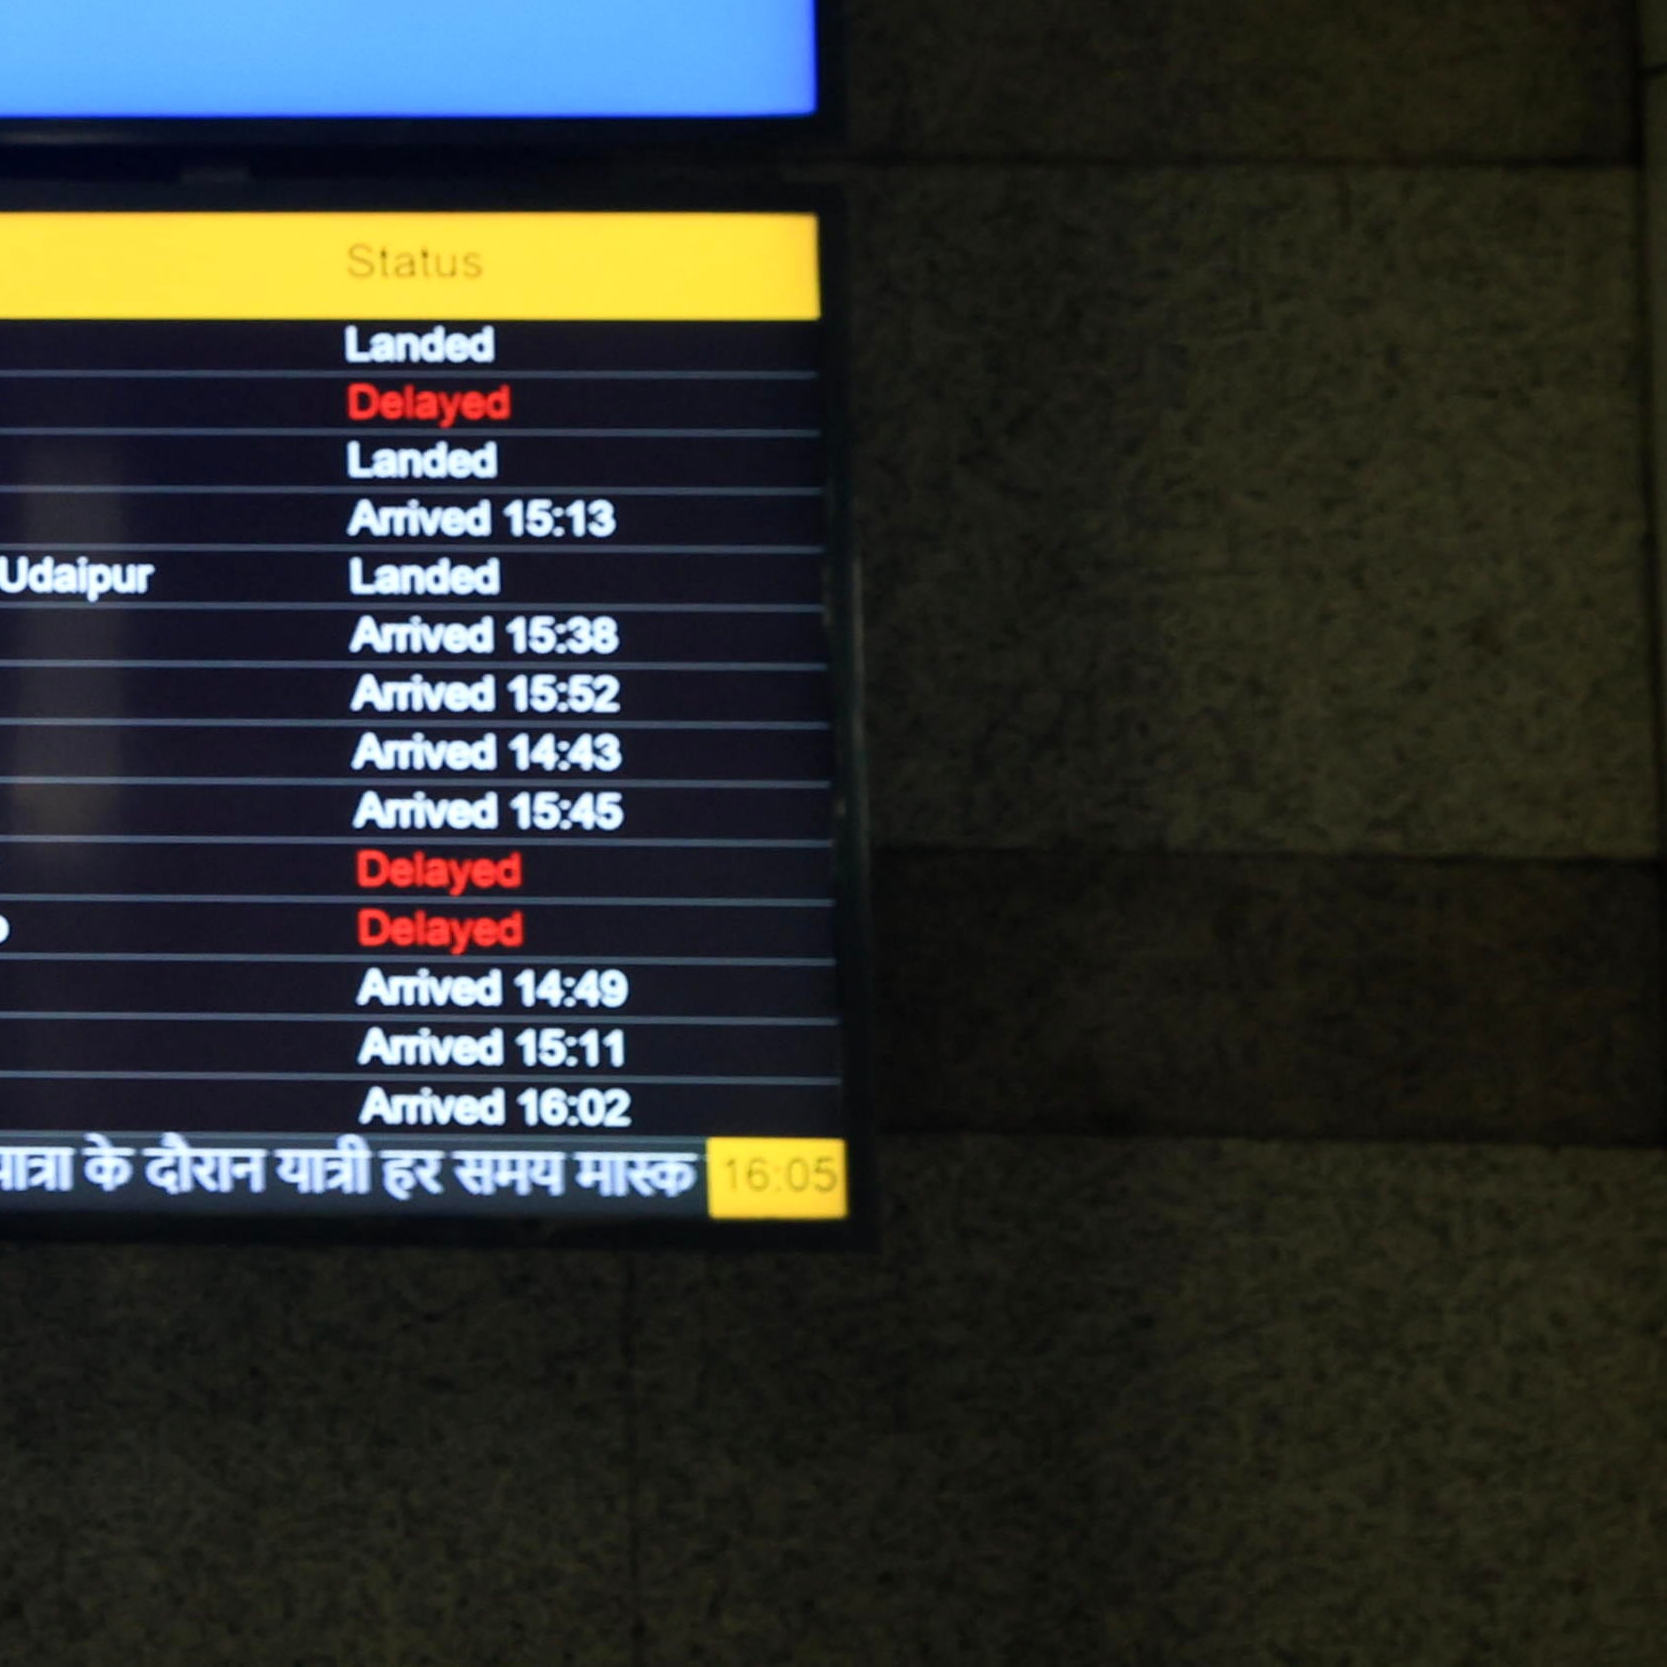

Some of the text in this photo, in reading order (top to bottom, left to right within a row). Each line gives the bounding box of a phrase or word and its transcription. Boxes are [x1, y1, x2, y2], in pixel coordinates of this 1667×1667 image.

[347, 243, 483, 279] Status
[345, 325, 495, 363] Landed
[347, 382, 511, 429] Delayed
[347, 440, 498, 479] Landed
[347, 498, 492, 537] Arrived
[504, 499, 616, 537] 15:13
[350, 557, 500, 595] Landed
[349, 615, 494, 654] Arrived
[506, 615, 619, 654] 15:38
[350, 674, 496, 712] Arrived
[508, 674, 621, 713] 15:52
[351, 732, 497, 770] Arrived
[509, 733, 622, 771] 14:43
[353, 791, 498, 829] Arrived
[510, 791, 624, 830] 15:45
[356, 850, 522, 897] Delayed
[358, 908, 524, 956] Delayed
[356, 967, 503, 1007] Arrived
[514, 969, 629, 1008] 14:49
[358, 1026, 504, 1066] Arrived
[516, 1028, 624, 1067] 15:11
[360, 1086, 505, 1126] Arrived
[517, 1087, 631, 1127] 16:02
[83, 1132, 135, 1191] के
[143, 1132, 267, 1194] दौरान
[275, 1133, 372, 1193] यात्री
[380, 1149, 445, 1200] हर
[452, 1150, 565, 1195] समय
[574, 1151, 698, 1196] मास्क
[726, 1155, 839, 1196] 16:05
